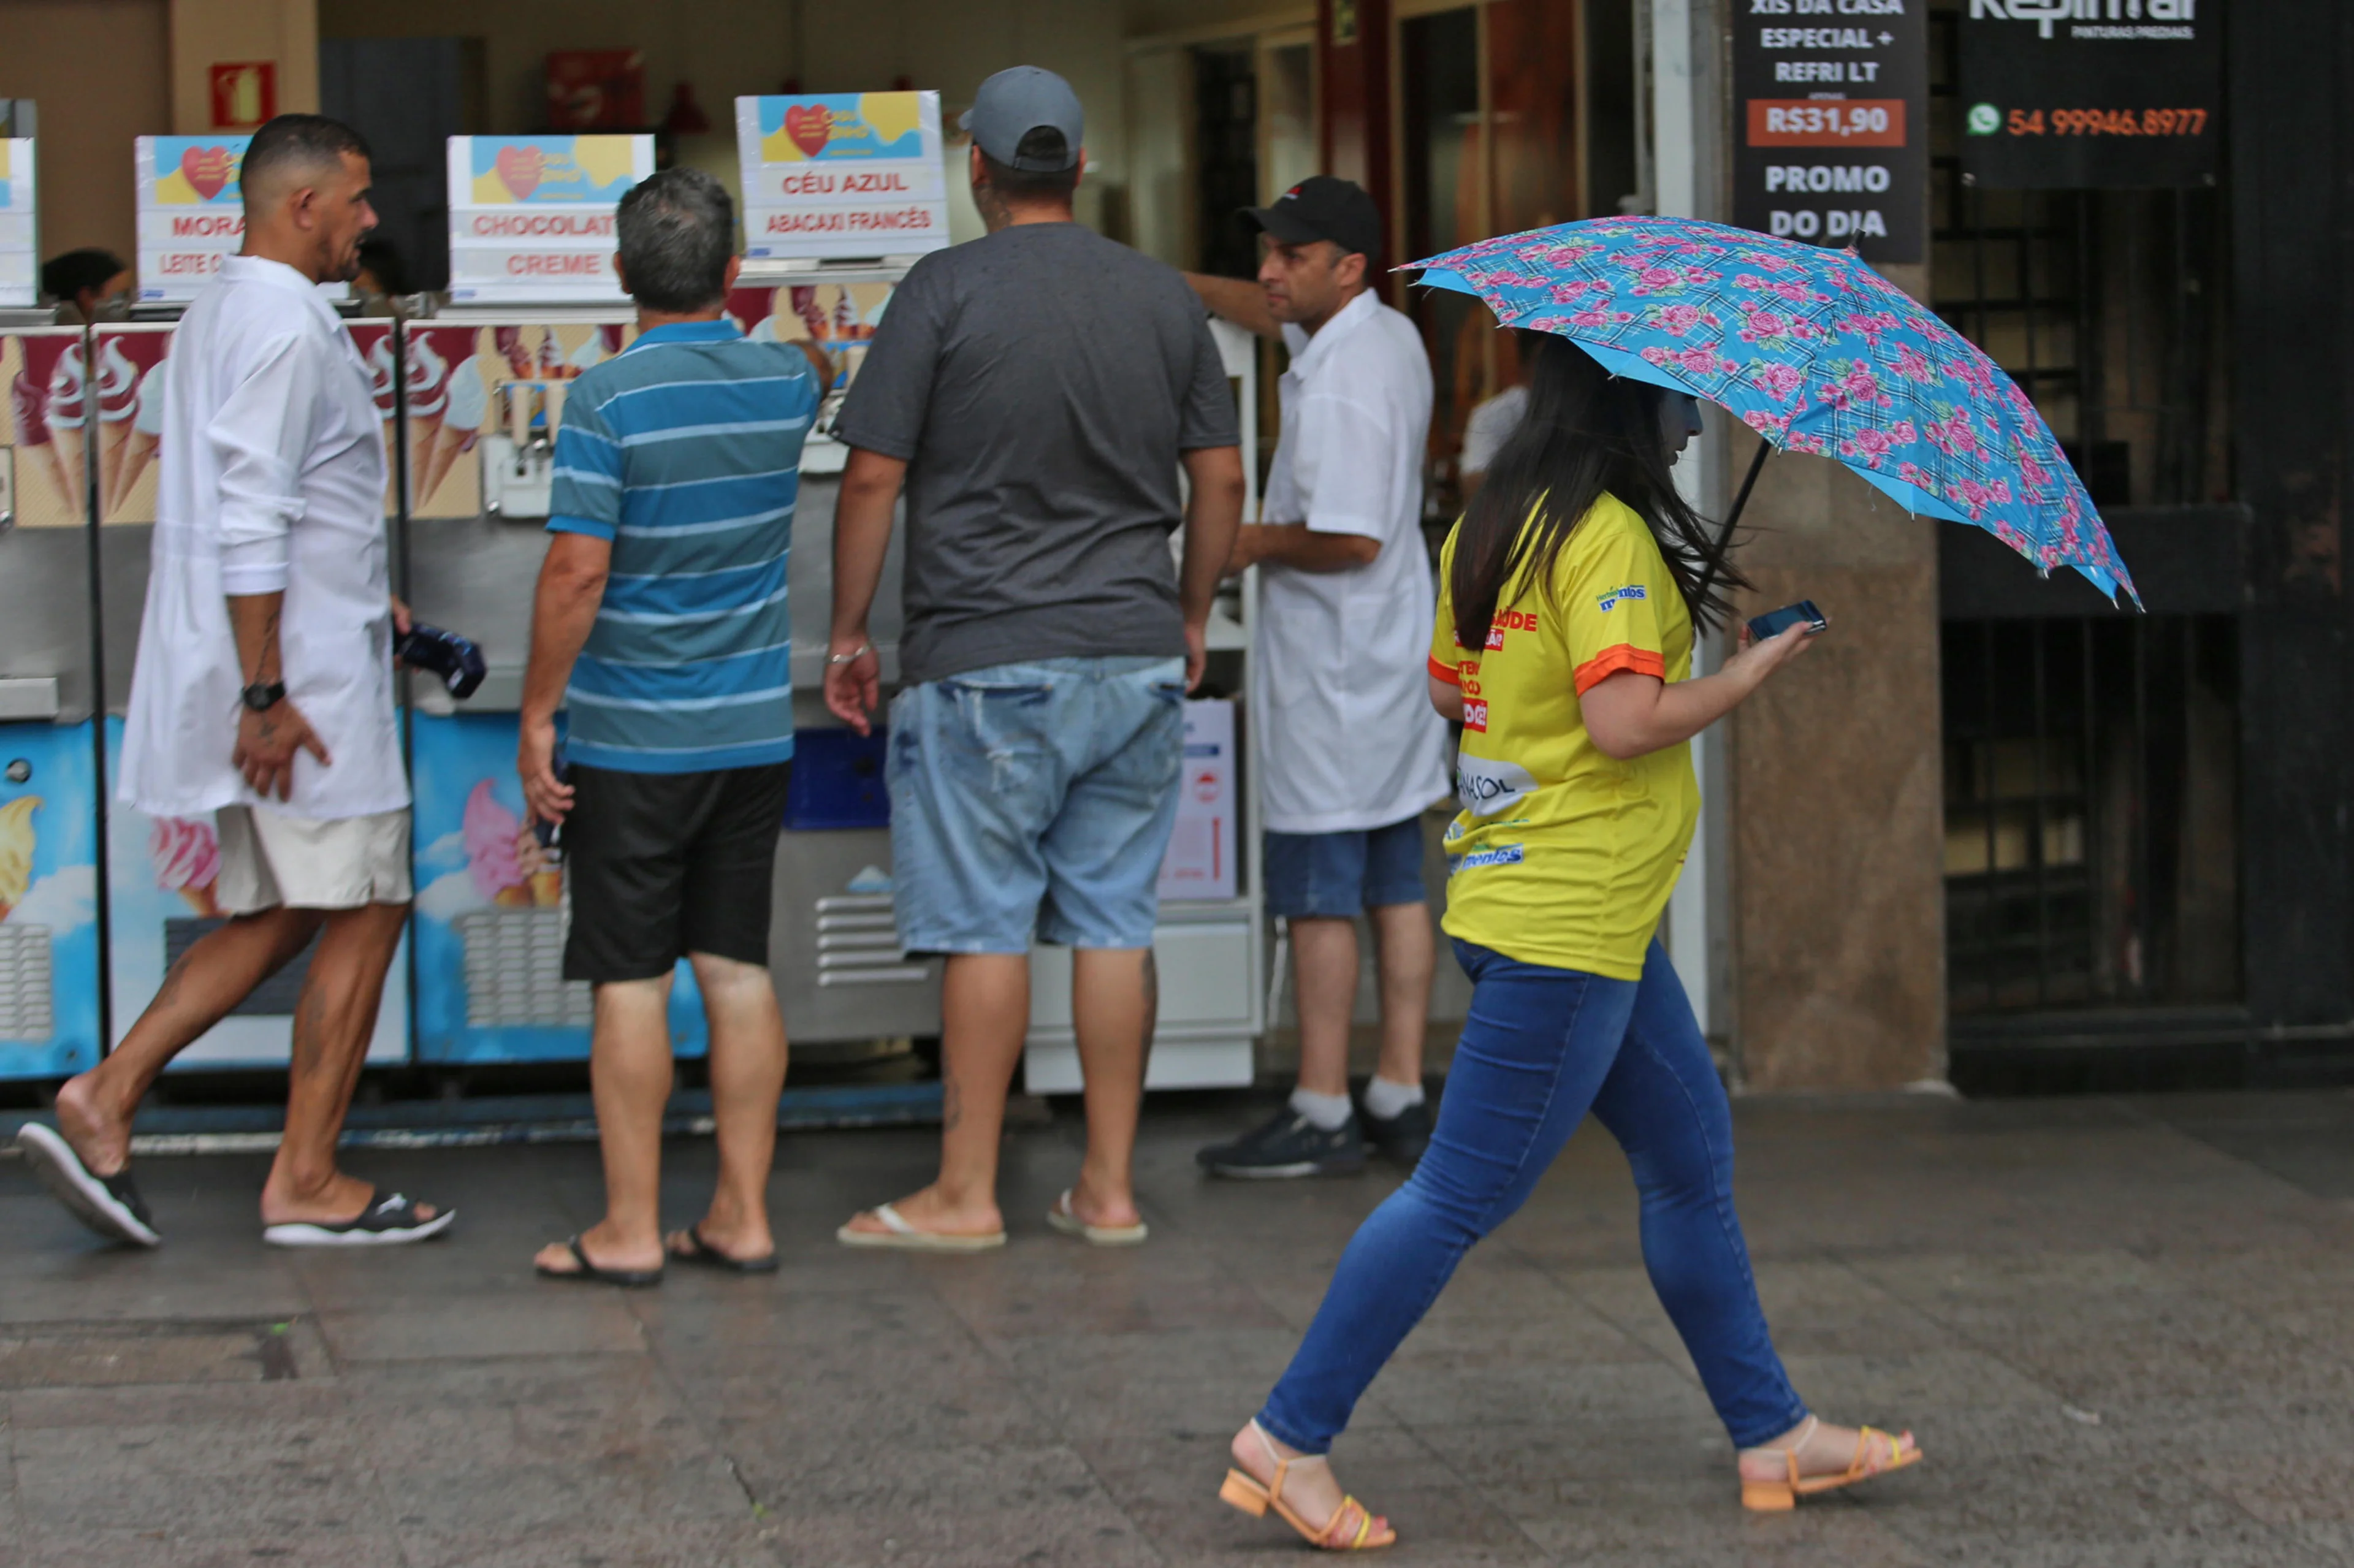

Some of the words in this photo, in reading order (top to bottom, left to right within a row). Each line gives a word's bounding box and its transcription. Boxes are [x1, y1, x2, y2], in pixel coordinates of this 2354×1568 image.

[1796, 0, 1833, 14] DA
[1837, 0, 1905, 14] CASA
[1760, 28, 1874, 48] ESPECIAL
[1775, 61, 1844, 82] REFRI
[1848, 62, 1880, 82] LT
[1766, 107, 1889, 137] R$31,90
[2006, 108, 2046, 136] 54
[782, 171, 835, 195] CÉU
[840, 173, 910, 193] AZUL
[1765, 166, 1891, 193] PROMO
[766, 213, 845, 234] ABACAXI
[1769, 210, 1821, 238] DO
[1826, 210, 1888, 238] DIA
[159, 253, 207, 274] LEITE
[506, 254, 601, 275] CREME
